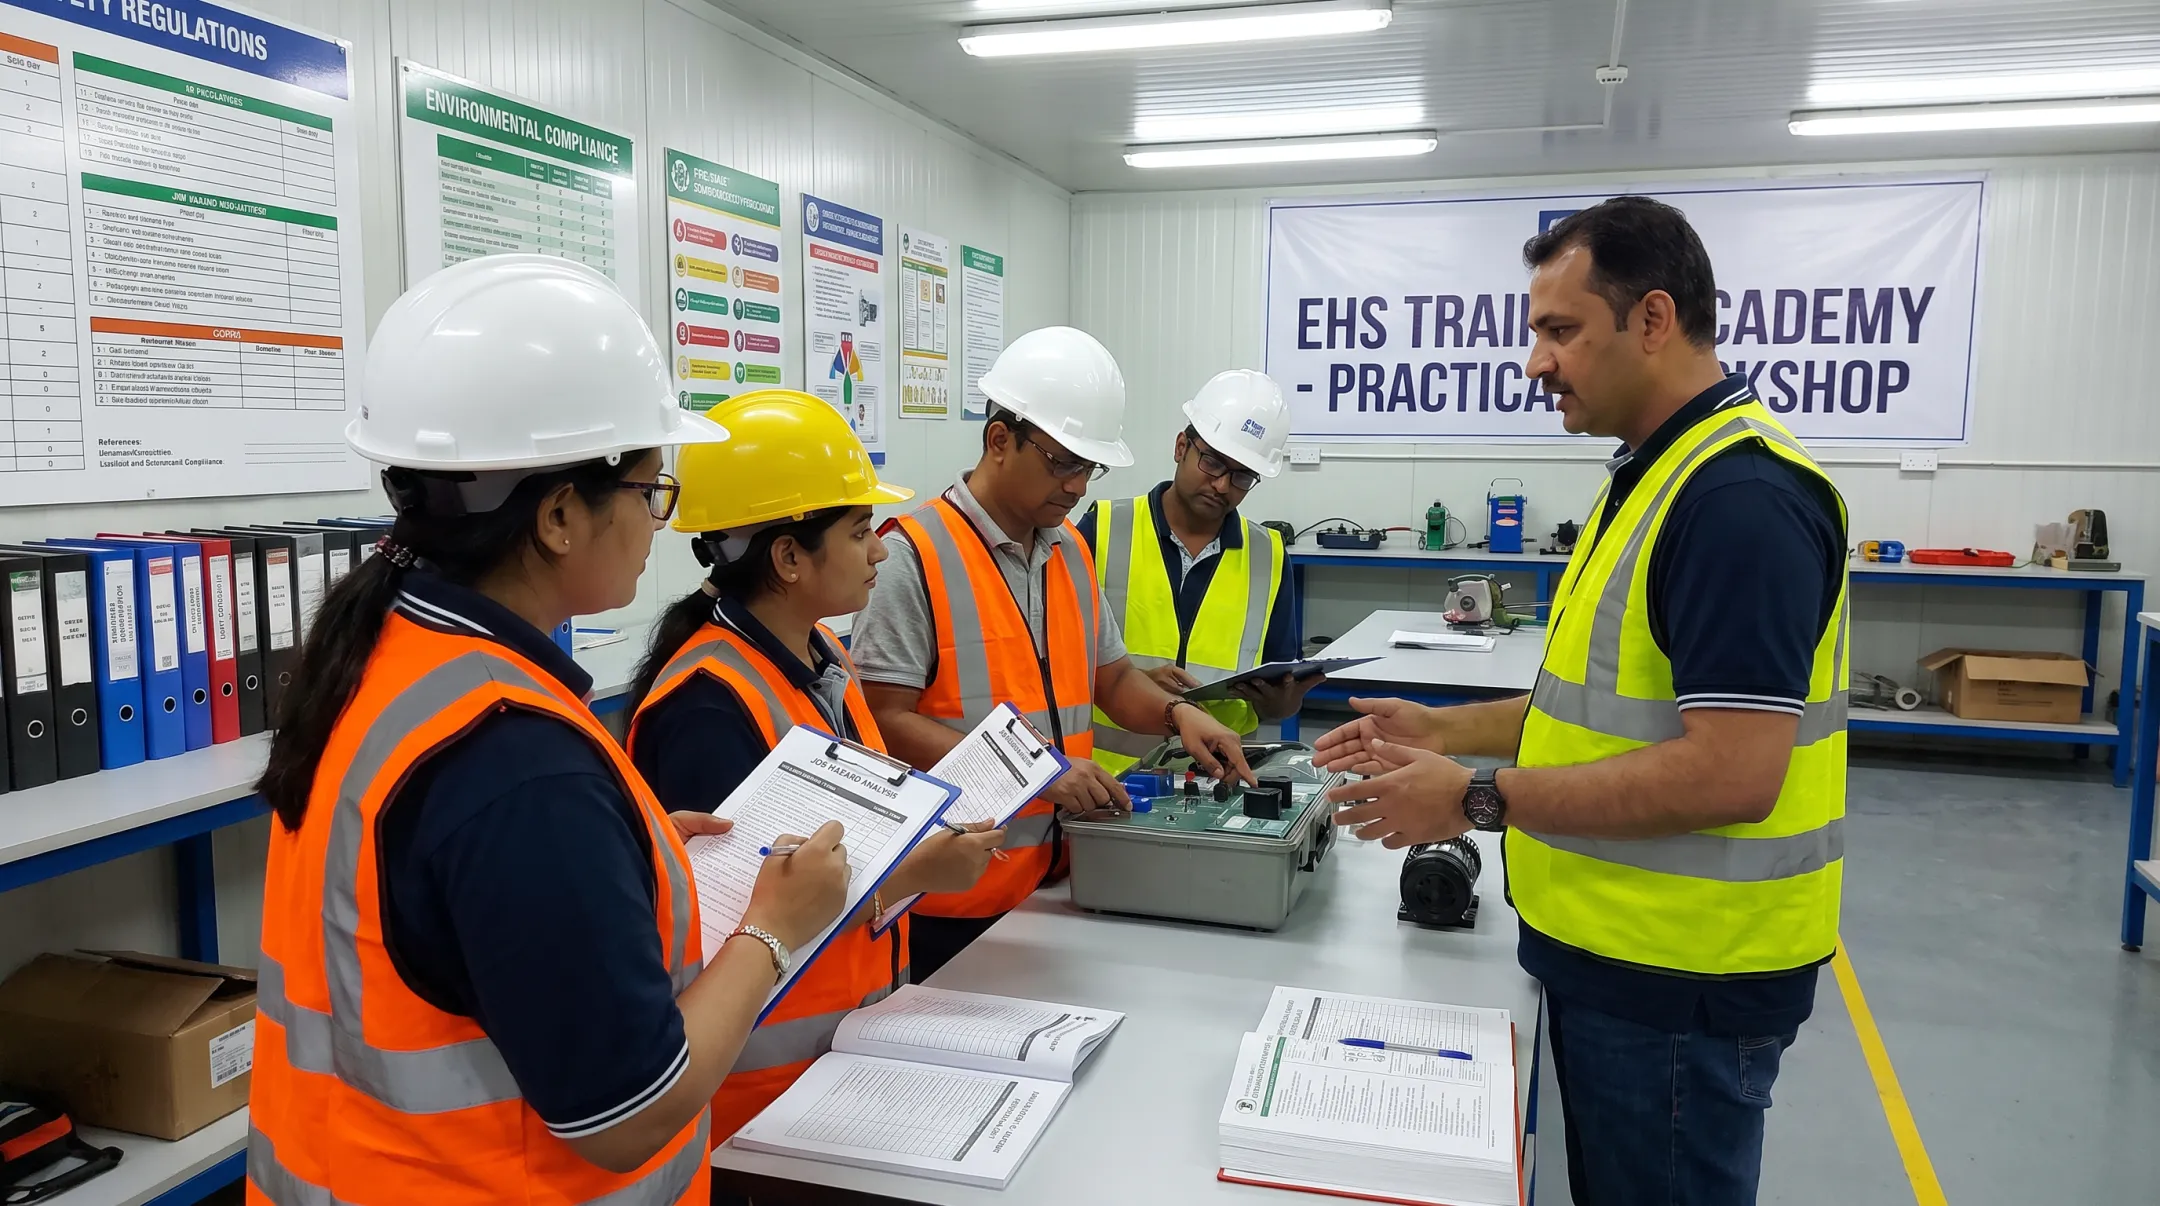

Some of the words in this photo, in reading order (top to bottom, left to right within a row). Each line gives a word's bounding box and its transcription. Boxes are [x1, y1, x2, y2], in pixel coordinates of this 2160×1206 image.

[122, 0, 267, 61] REGULATIONS
[425, 87, 542, 142] ENVIRONMENTAL
[544, 124, 619, 165] COMPLIANCE
[1298, 296, 1388, 350] EHS
[1404, 293, 1530, 349] TRAI
[1715, 286, 1936, 346] CADEMY
[1329, 362, 1555, 413] PRACTICA
[1718, 359, 1910, 414] KSHOP
[98, 438, 142, 446] References:
[130, 459, 144, 467] and
[861, 779, 899, 800] ANALYSIS
